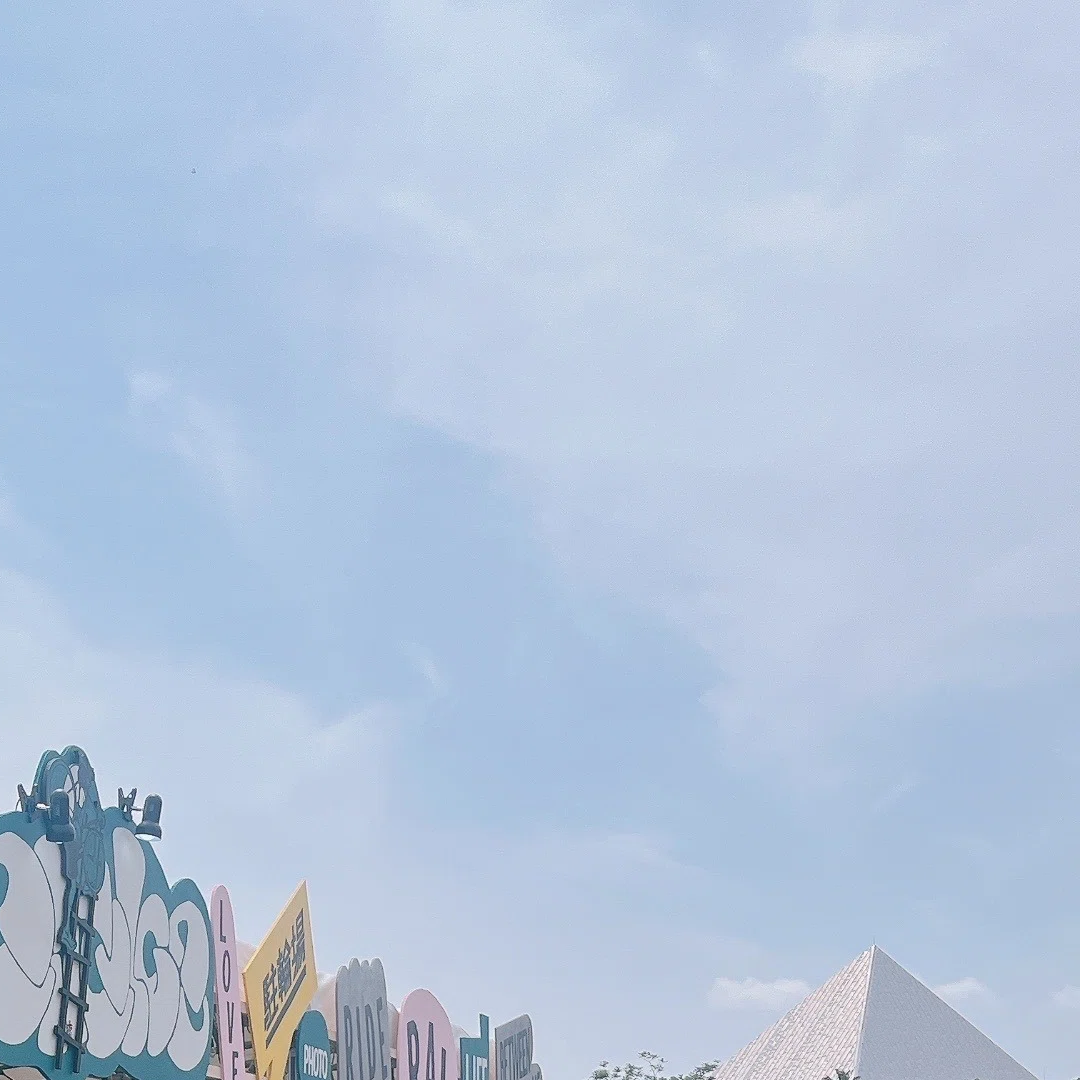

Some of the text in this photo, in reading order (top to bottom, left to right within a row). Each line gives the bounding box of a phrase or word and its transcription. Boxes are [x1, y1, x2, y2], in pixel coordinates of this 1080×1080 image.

[262, 907, 306, 1032] 駐輪場
[303, 1043, 329, 1080] PHOTO
